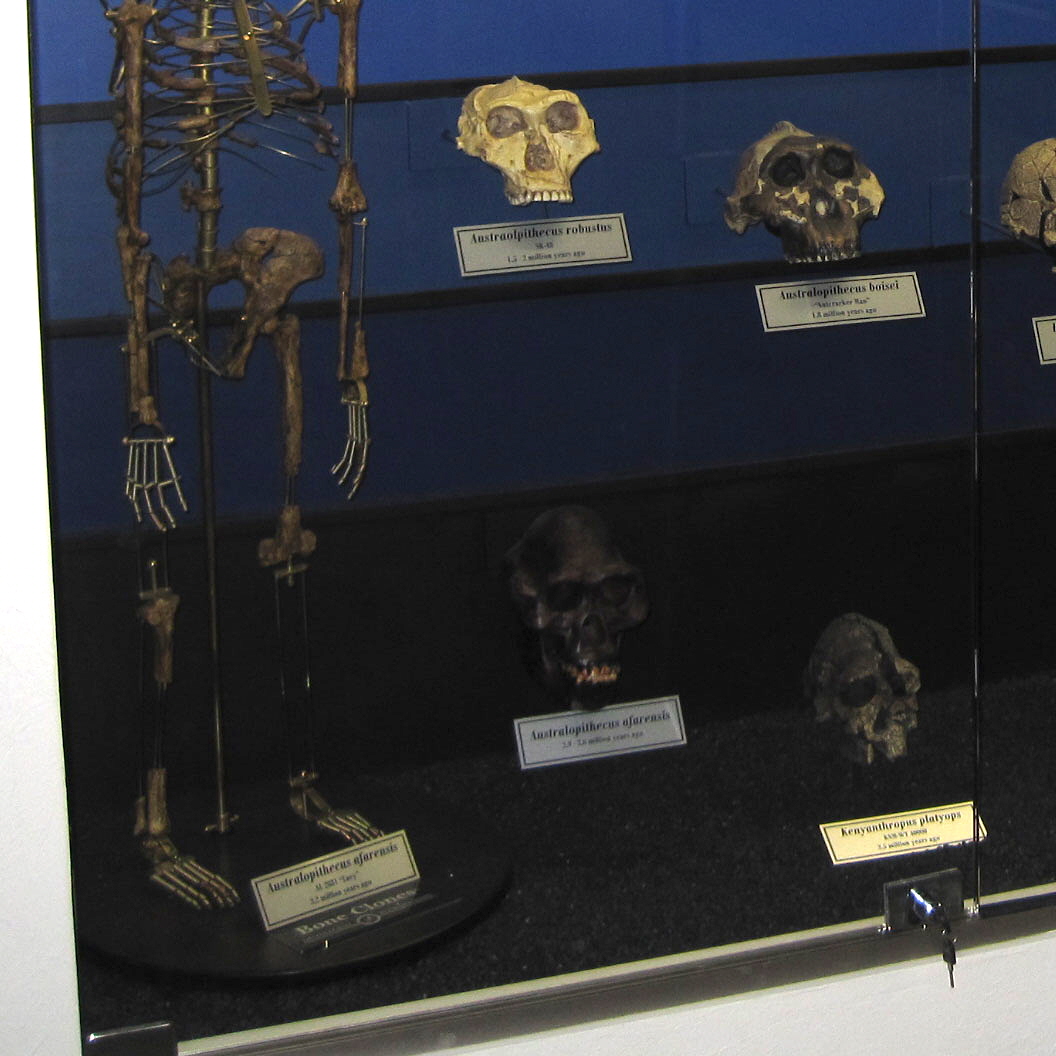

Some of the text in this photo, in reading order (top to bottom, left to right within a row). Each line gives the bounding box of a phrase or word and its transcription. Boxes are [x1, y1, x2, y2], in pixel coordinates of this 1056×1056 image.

[566, 223, 613, 234] robustus
[779, 280, 899, 300] Australopithecus boisei
[531, 710, 671, 741] Australopithecus afarensis
[841, 811, 961, 836] Kenyanthropus platyops
[268, 842, 398, 893] Australopithecus afarensis
[296, 889, 417, 935] Bone Clones
